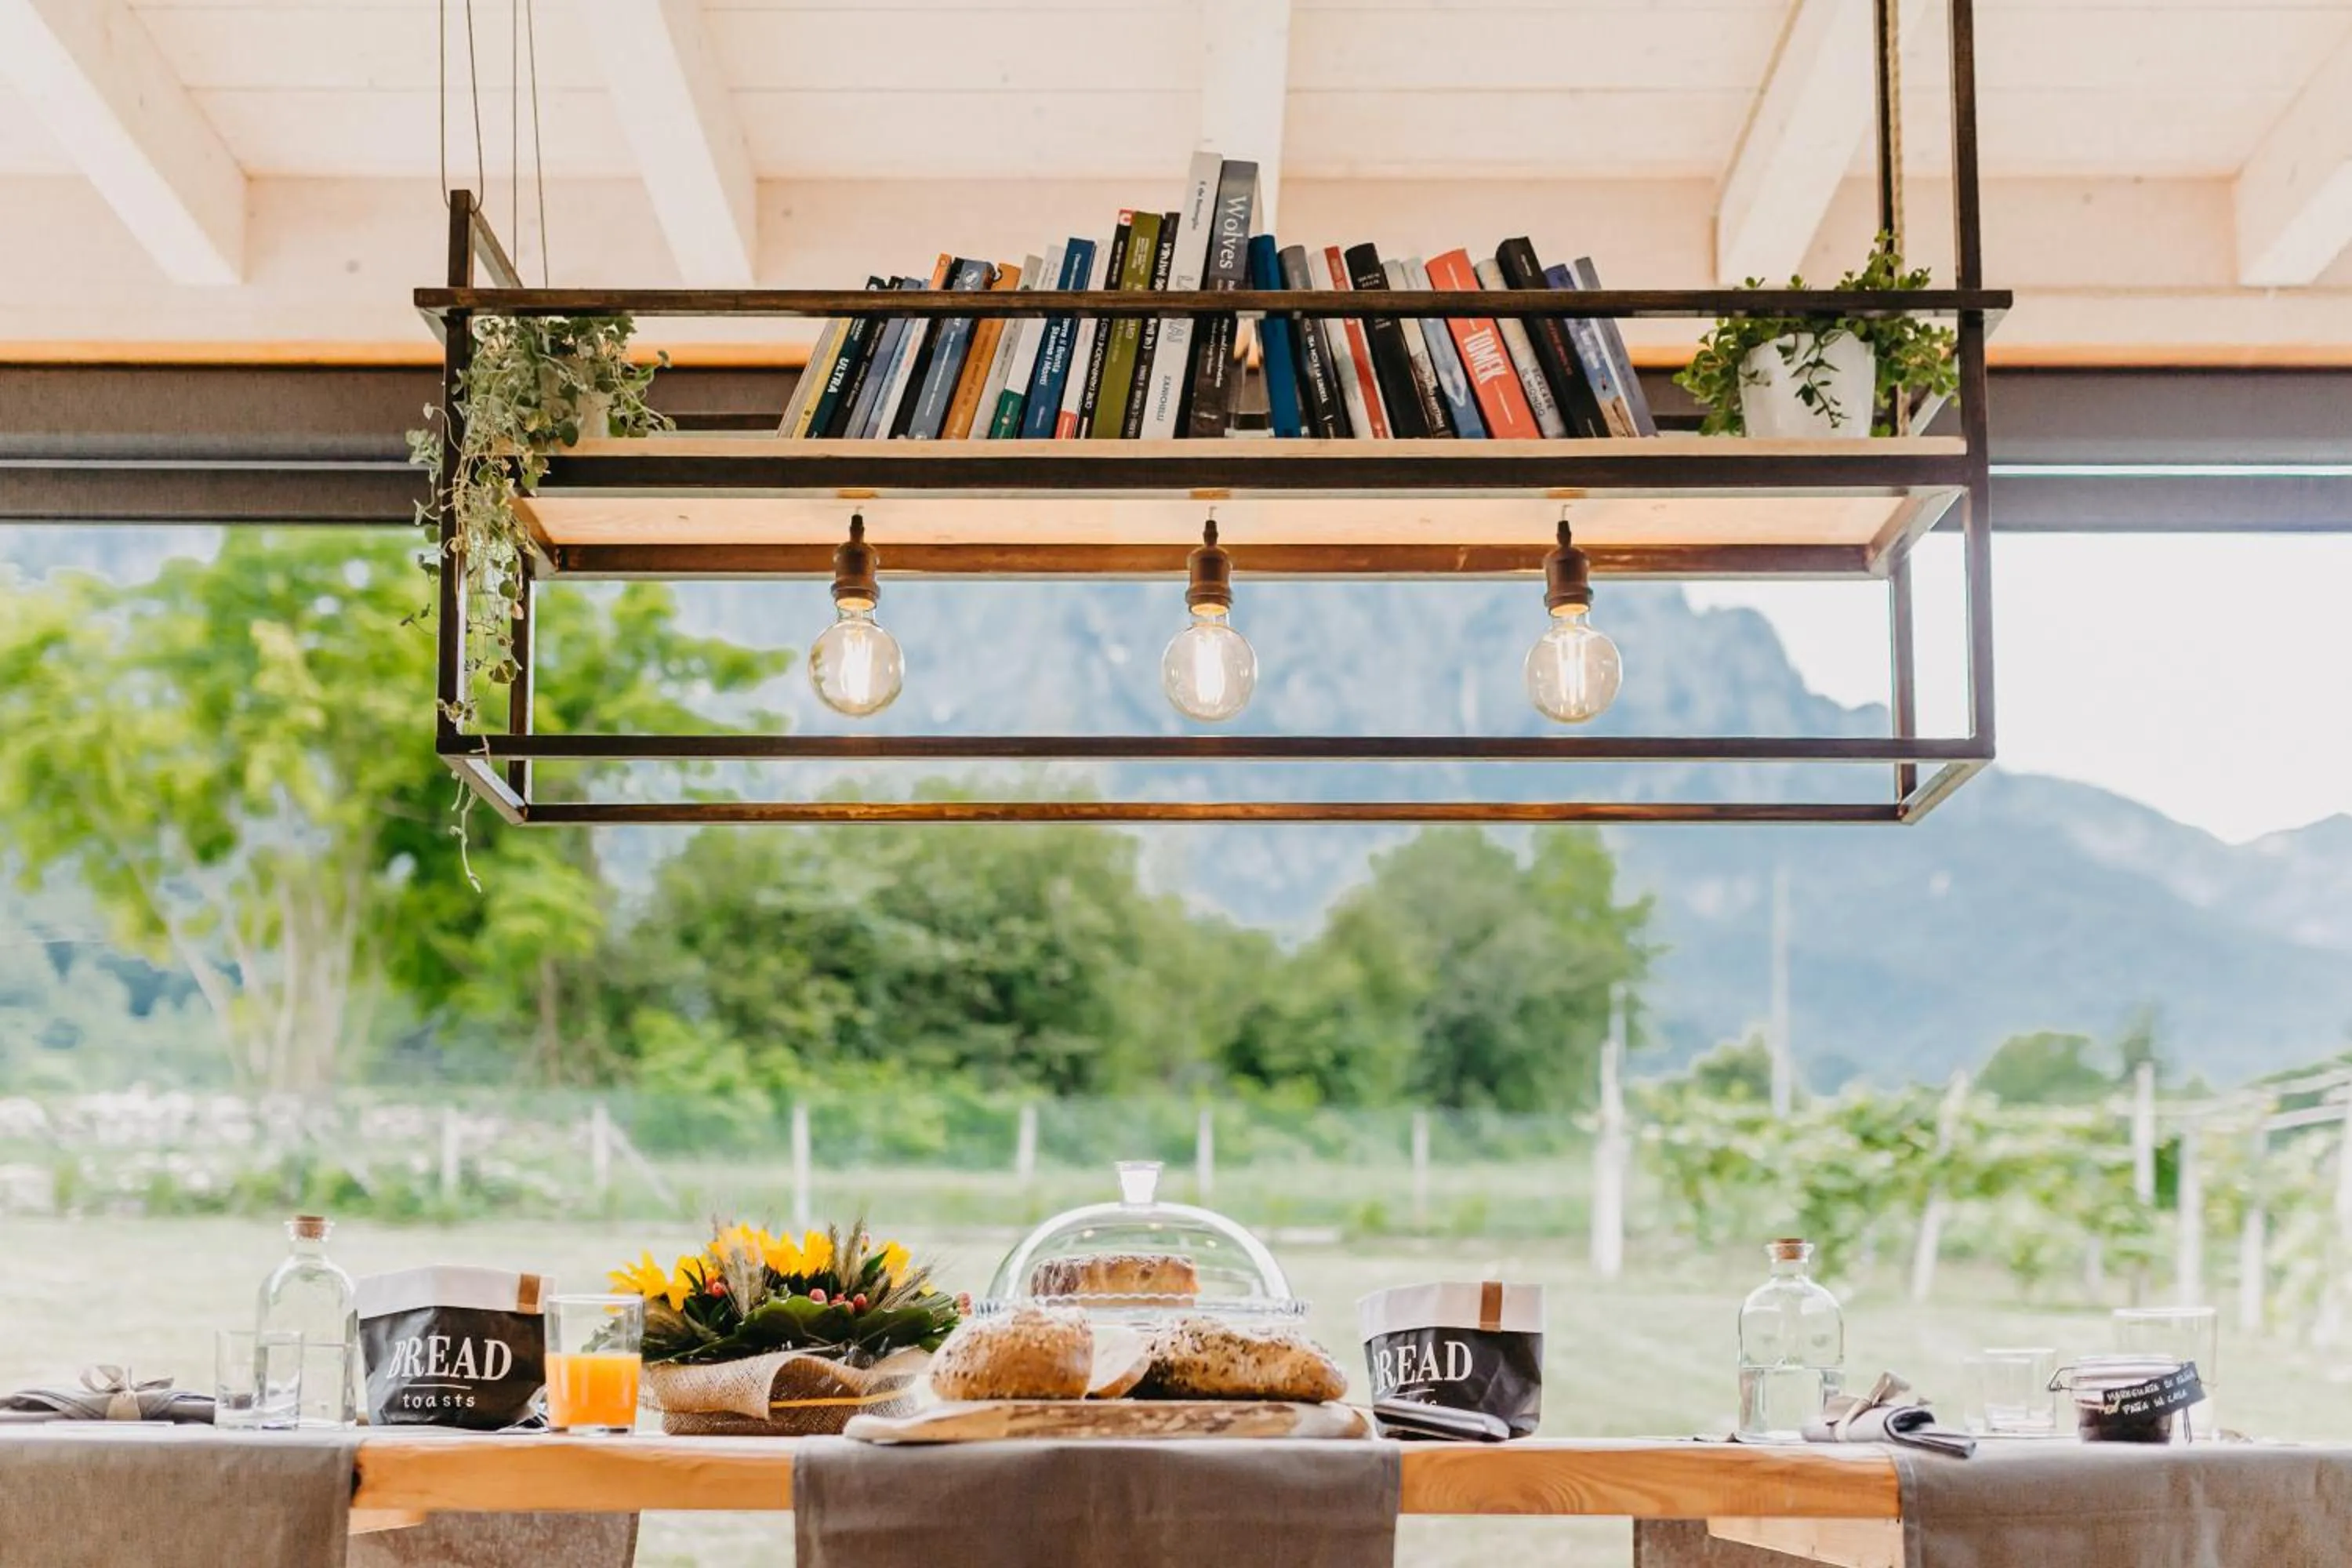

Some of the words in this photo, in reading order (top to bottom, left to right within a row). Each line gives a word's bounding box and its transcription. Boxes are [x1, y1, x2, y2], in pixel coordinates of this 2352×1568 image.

[1219, 195, 1247, 269] Wolves
[827, 357, 849, 394] ULTRA
[1464, 328, 1508, 383] TOMEK
[387, 1334, 512, 1381] BREAD
[402, 1393, 476, 1408] toasts
